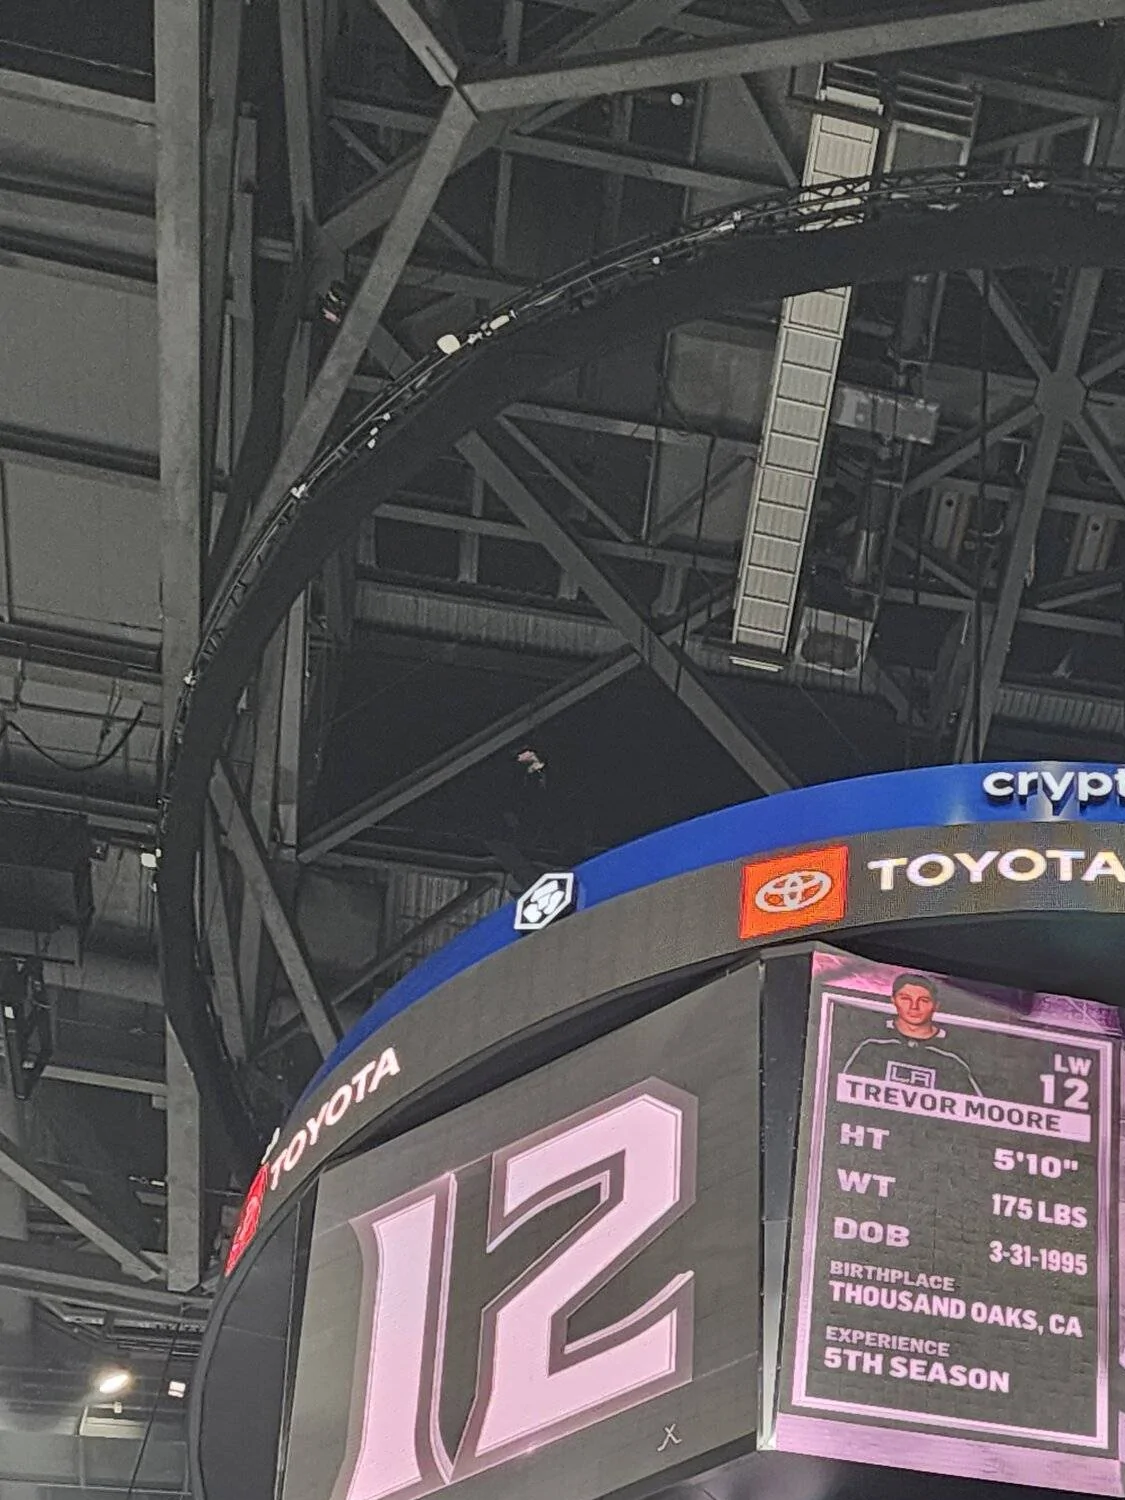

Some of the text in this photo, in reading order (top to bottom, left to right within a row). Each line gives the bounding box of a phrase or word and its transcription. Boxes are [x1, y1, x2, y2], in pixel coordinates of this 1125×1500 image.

[1040, 1074, 1090, 1110] 12
[1054, 1054, 1092, 1077] LW
[270, 1047, 400, 1190] TOYOTA
[846, 1079, 1061, 1132] TREVOR MOORE
[840, 1123, 1079, 1180] HT 5'10"
[837, 1169, 1088, 1229] WT 175 LBS
[833, 1217, 1088, 1276] DOB 3-31-1995
[830, 1260, 955, 1292] BIRTHPLACE
[828, 1280, 1083, 1337] THOUSAND OAKS, CA
[826, 1326, 950, 1357] EXPERIENCE
[824, 1347, 1010, 1393] 5TH SEASON
